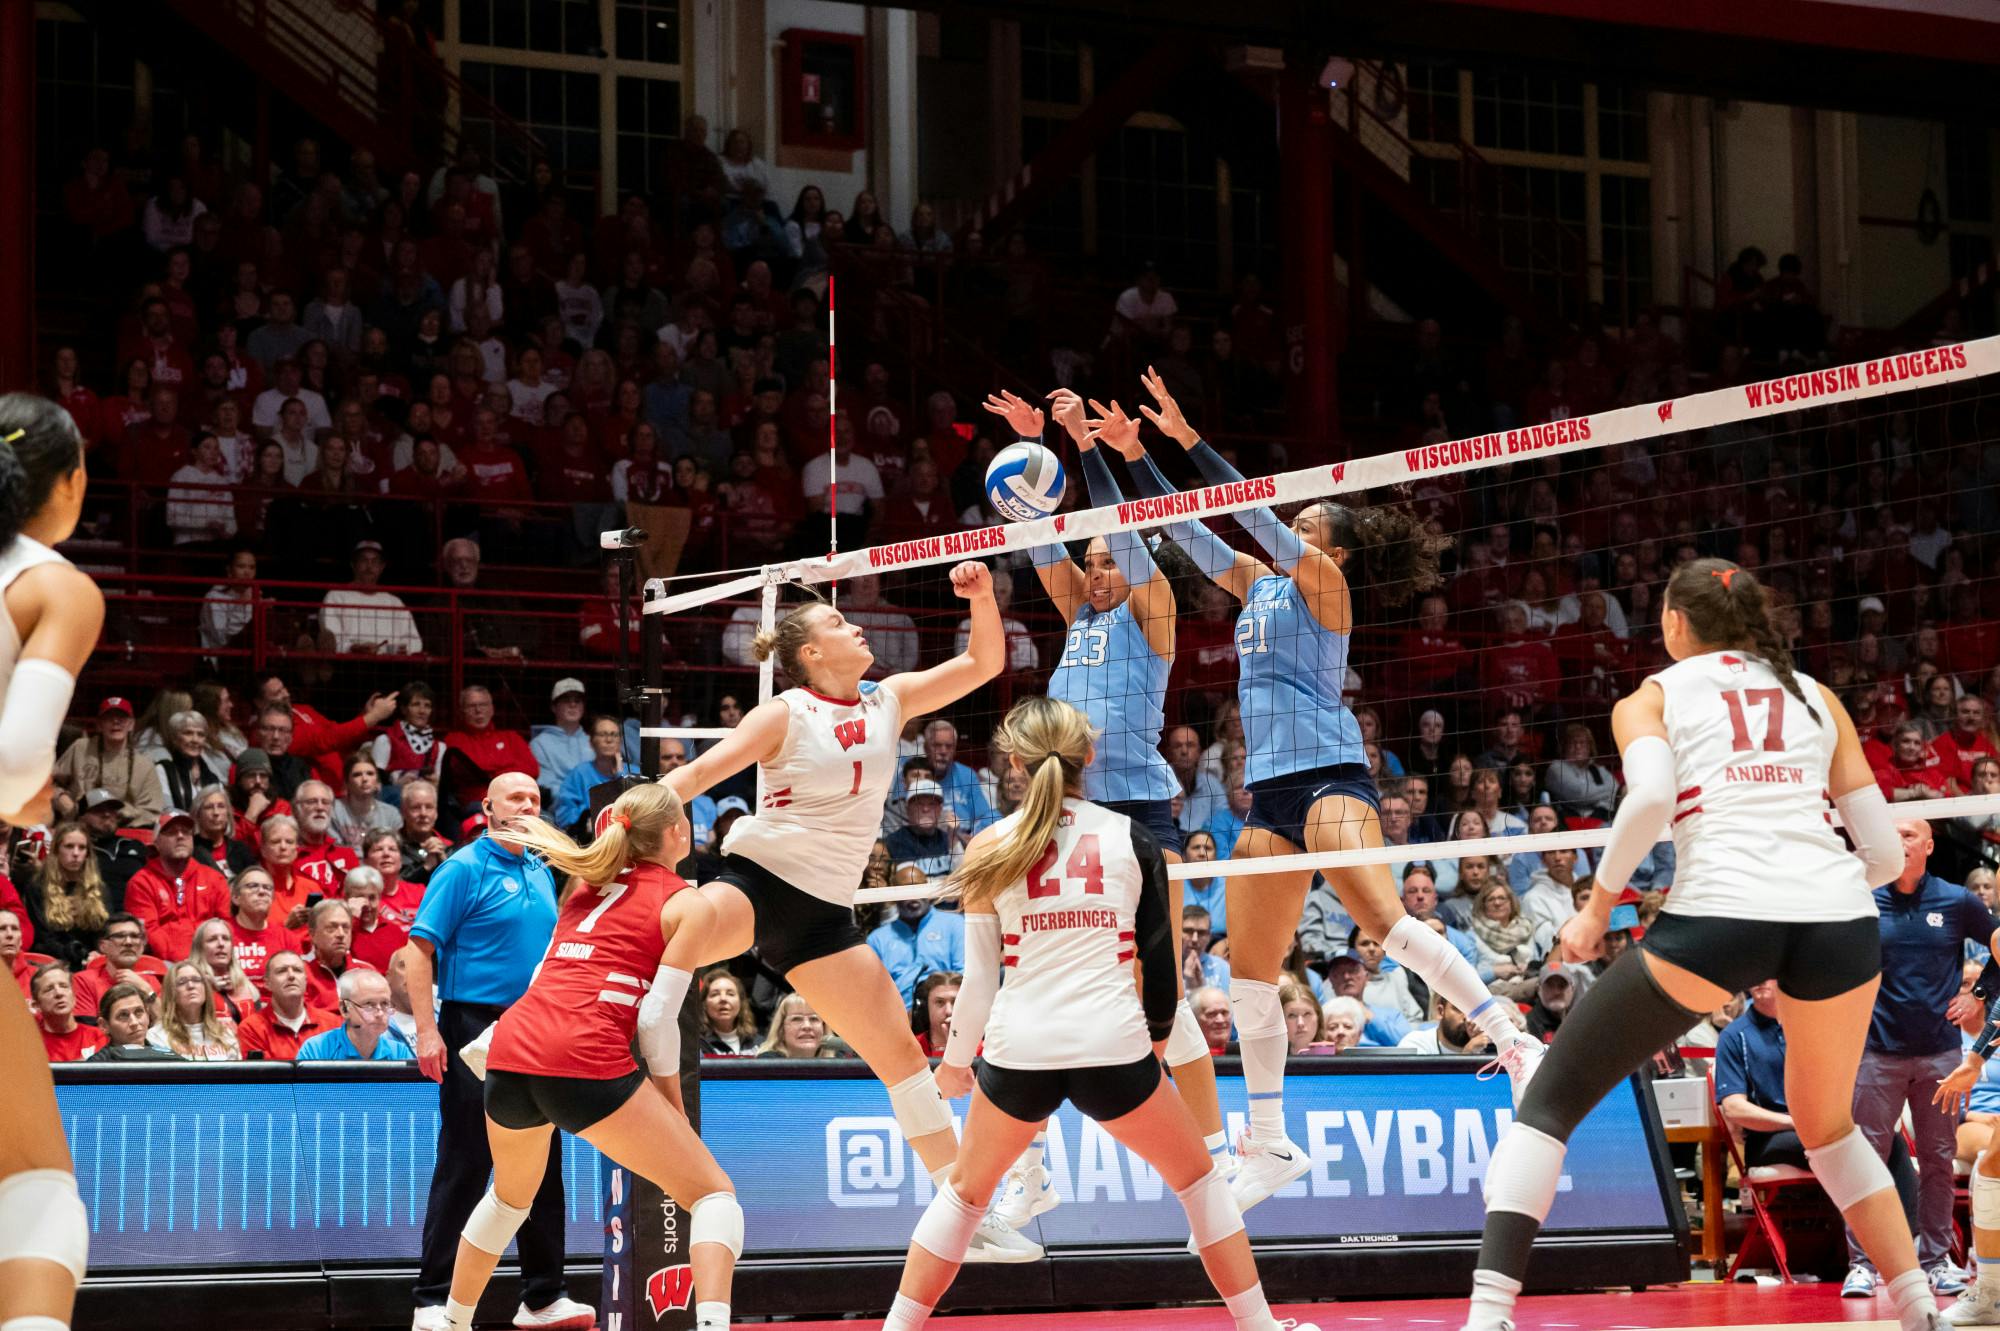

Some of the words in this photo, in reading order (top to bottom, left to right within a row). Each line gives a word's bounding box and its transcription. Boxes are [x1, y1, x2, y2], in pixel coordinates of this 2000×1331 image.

[1745, 364, 1860, 408] WISCONSIN
[1865, 344, 1967, 386] BADGERS
[1405, 433, 1501, 472] WISCONSIN
[1506, 417, 1592, 455] BADGERS
[1117, 491, 1201, 525] WISCONSIN
[1204, 476, 1276, 509] BADGERS
[869, 537, 941, 567] WISCONSIN
[944, 526, 1006, 556] BADGERS
[1061, 629, 1108, 667] 23
[1237, 615, 1268, 656] 21
[834, 719, 866, 752] W
[1720, 688, 1785, 752] 17
[850, 761, 862, 795] 1
[1725, 765, 1804, 784] ANDREW
[1026, 833, 1104, 900] 24
[577, 882, 628, 933] 7
[1021, 910, 1118, 933] FUERBRINGER
[556, 942, 595, 959] SIMON
[660, 1191, 679, 1253] ports
[1340, 1234, 1399, 1243] DAKTRONICS
[646, 1264, 694, 1322] W
